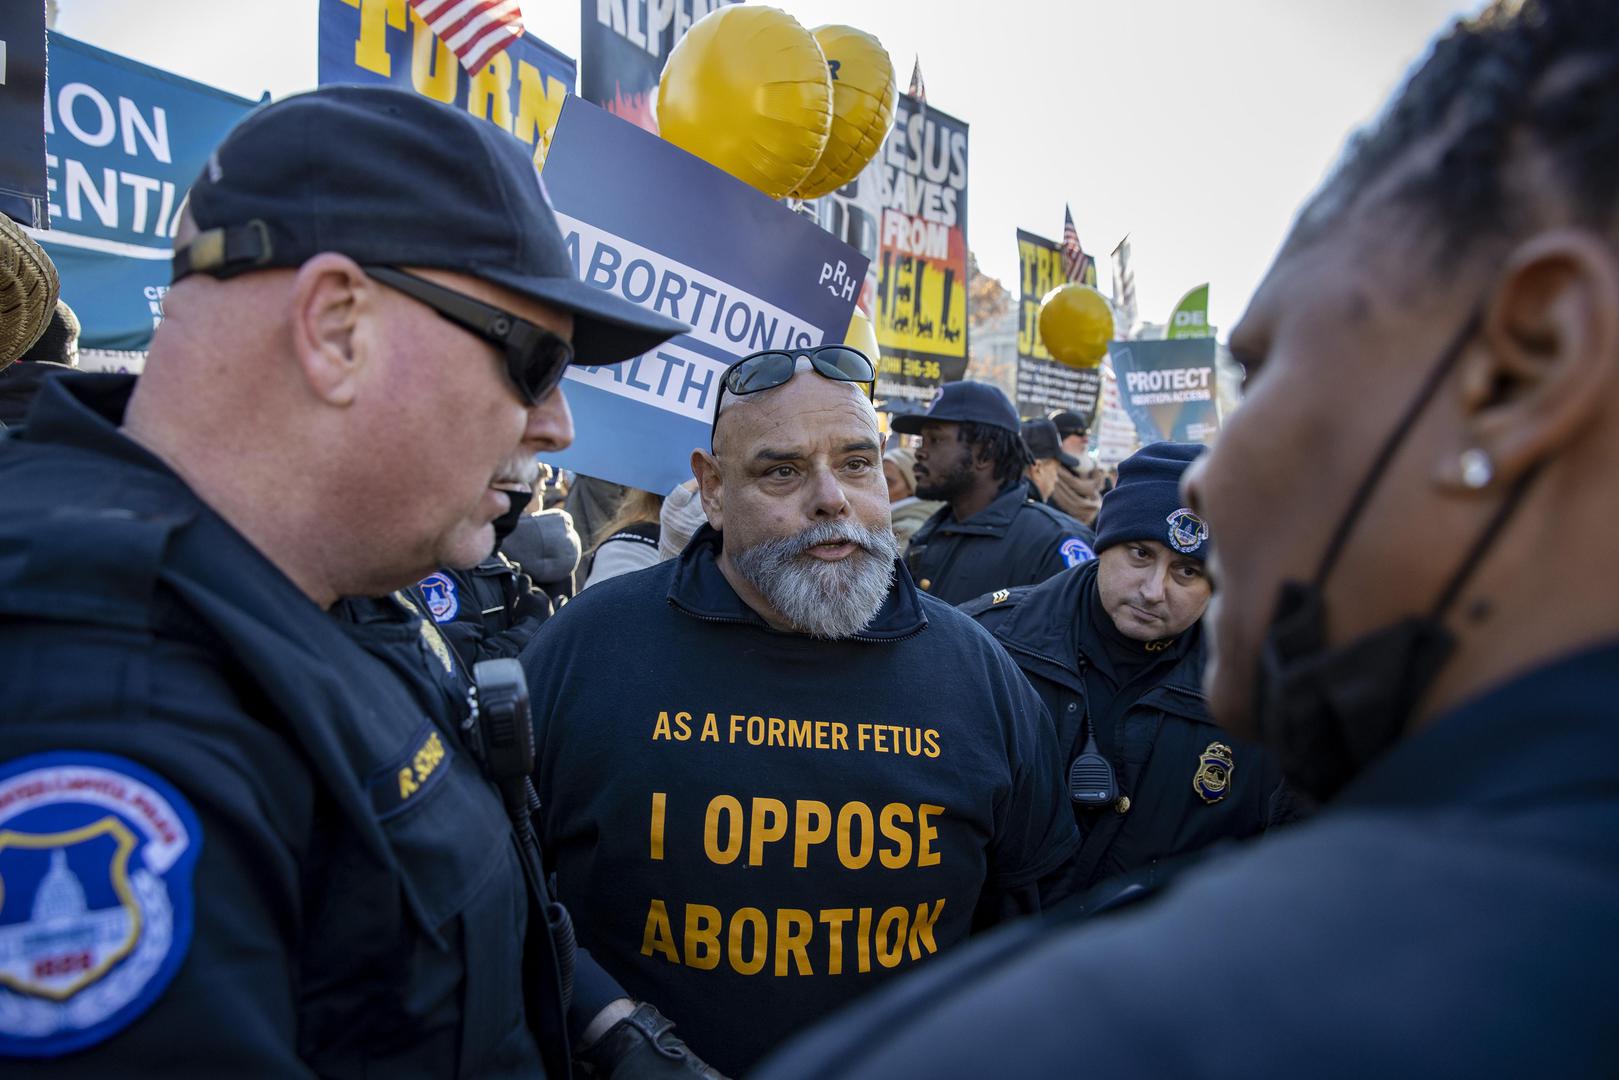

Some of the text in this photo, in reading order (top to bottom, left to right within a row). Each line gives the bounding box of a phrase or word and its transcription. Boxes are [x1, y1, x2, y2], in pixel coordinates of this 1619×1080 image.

[886, 106, 967, 191] ESUS
[881, 164, 957, 228] SAVES
[883, 208, 948, 260] FROM
[563, 231, 778, 350] ABORTION
[819, 260, 856, 301] PRH
[1126, 367, 1211, 392] PROTECT
[652, 711, 941, 758] AS A FORMER FETUS
[650, 793, 946, 869] I OPPOSE
[640, 898, 946, 977] ABORTION
